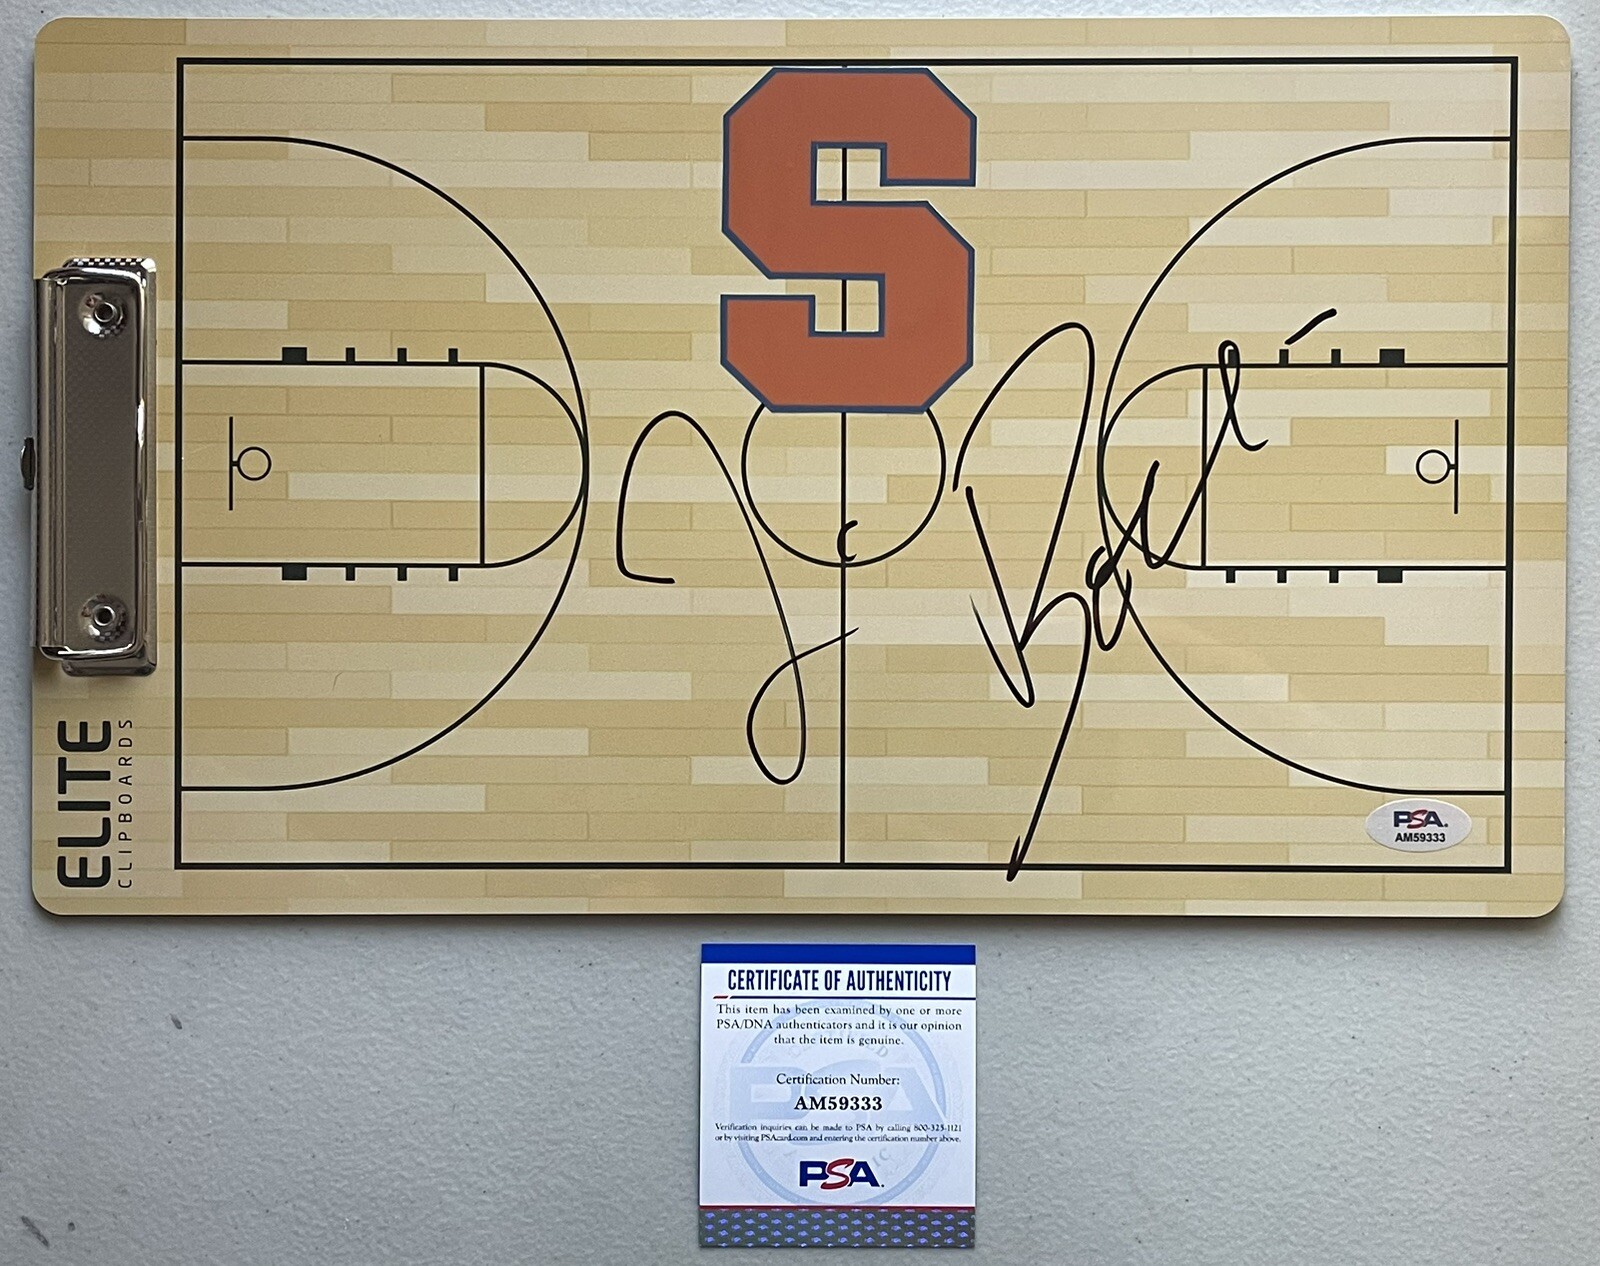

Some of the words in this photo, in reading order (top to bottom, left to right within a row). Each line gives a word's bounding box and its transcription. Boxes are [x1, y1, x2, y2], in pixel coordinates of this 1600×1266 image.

[720, 67, 977, 414] S
[57, 720, 111, 888] ELITE
[118, 719, 133, 889] CLIPBOARDS
[1394, 832, 1446, 843] AM59333
[728, 969, 819, 991] CERTIFICATE
[824, 969, 842, 991] OF
[846, 969, 951, 992] AUTHENTICITY
[717, 1004, 741, 1015] This
[745, 1004, 769, 1015] item
[773, 1004, 791, 1015] has
[795, 1004, 820, 1015] been
[824, 1004, 875, 1015] examined
[879, 1004, 892, 1017] by
[896, 1007, 915, 1015] one
[919, 1007, 931, 1015] or
[935, 1007, 962, 1015] more
[716, 1019, 773, 1030] PSA/DNA
[776, 1019, 852, 1030] authenticators
[855, 1020, 875, 1030] and
[878, 1020, 885, 1030] it
[888, 1020, 897, 1030] is
[900, 1022, 918, 1031] our
[921, 1021, 962, 1032] opinion
[774, 1035, 795, 1045] that
[799, 1035, 816, 1045] the
[820, 1035, 843, 1045] item
[847, 1035, 855, 1045] is
[858, 1035, 904, 1047] genuine.
[776, 1072, 846, 1085] Certification
[850, 1073, 900, 1085] Number:
[794, 1096, 883, 1111] AM59333
[715, 1123, 757, 1131] Verification
[760, 1123, 792, 1132] inquiries
[811, 1123, 820, 1131] be
[822, 1123, 842, 1131] made
[856, 1123, 872, 1131] PSA
[875, 1124, 884, 1133] by
[887, 1124, 911, 1133] calling
[724, 1134, 732, 1142] by
[734, 1134, 759, 1142] visiting
[809, 1134, 823, 1142] and
[824, 1134, 853, 1143] entering
[855, 1134, 866, 1142] the
[868, 1134, 909, 1142] certification
